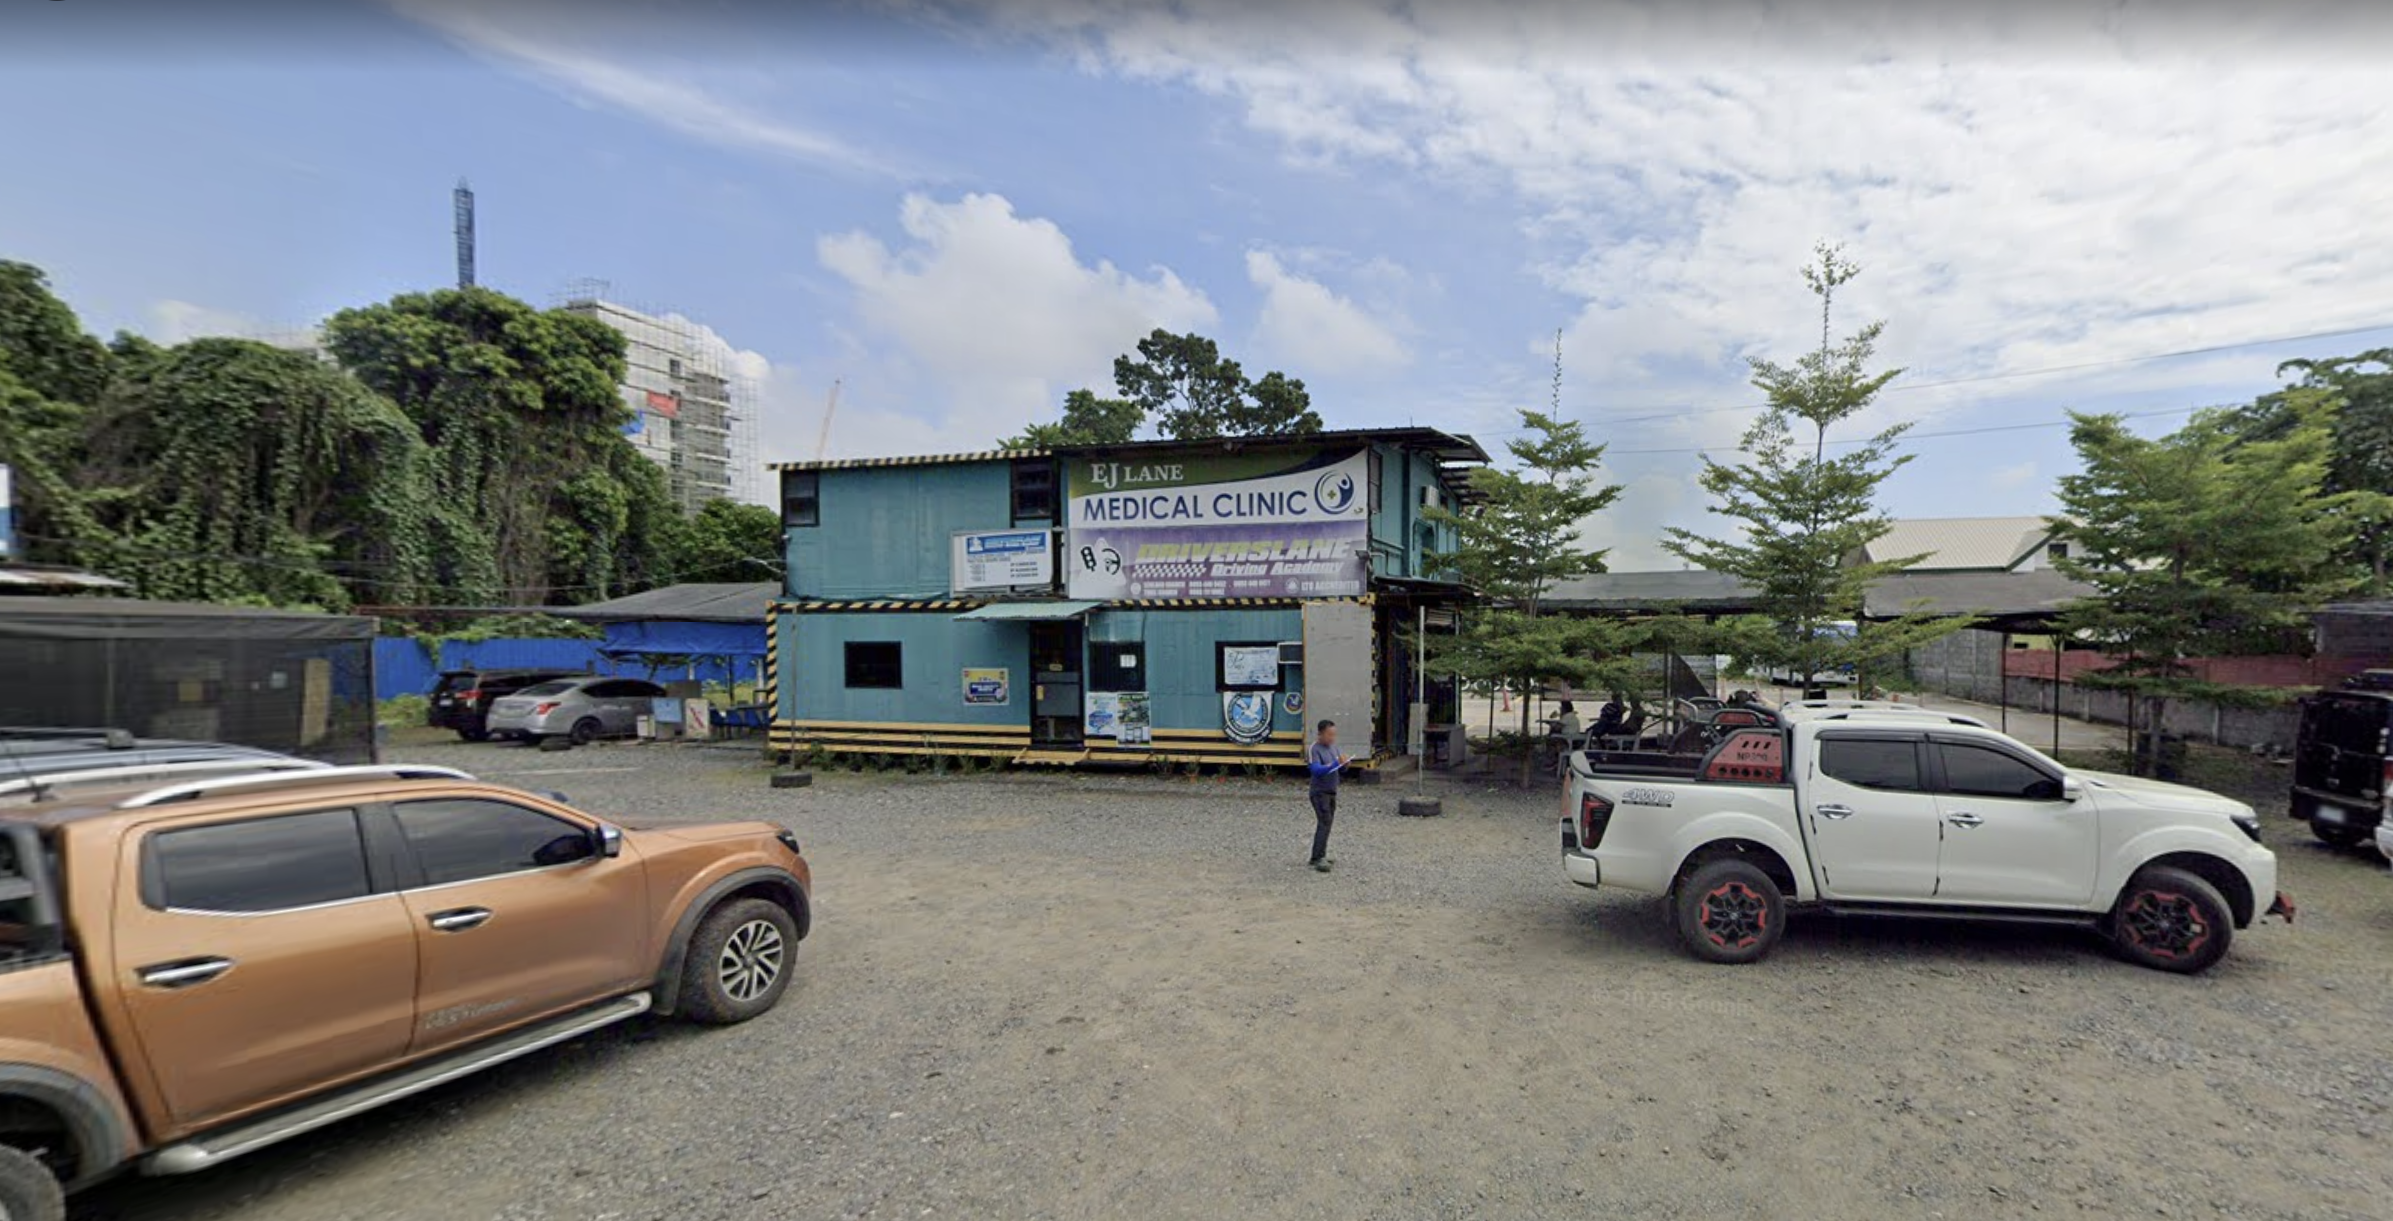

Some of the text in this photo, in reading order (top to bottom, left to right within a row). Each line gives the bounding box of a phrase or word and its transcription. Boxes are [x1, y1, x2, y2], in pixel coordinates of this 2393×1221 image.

[1091, 463, 1184, 489] EJ LANE
[1083, 490, 1308, 521] MEDICAL CLINIC
[1135, 539, 1352, 563] DRIVERSLANE
[1210, 560, 1345, 577] Driving Academy
[1622, 788, 1675, 803] 4WD
